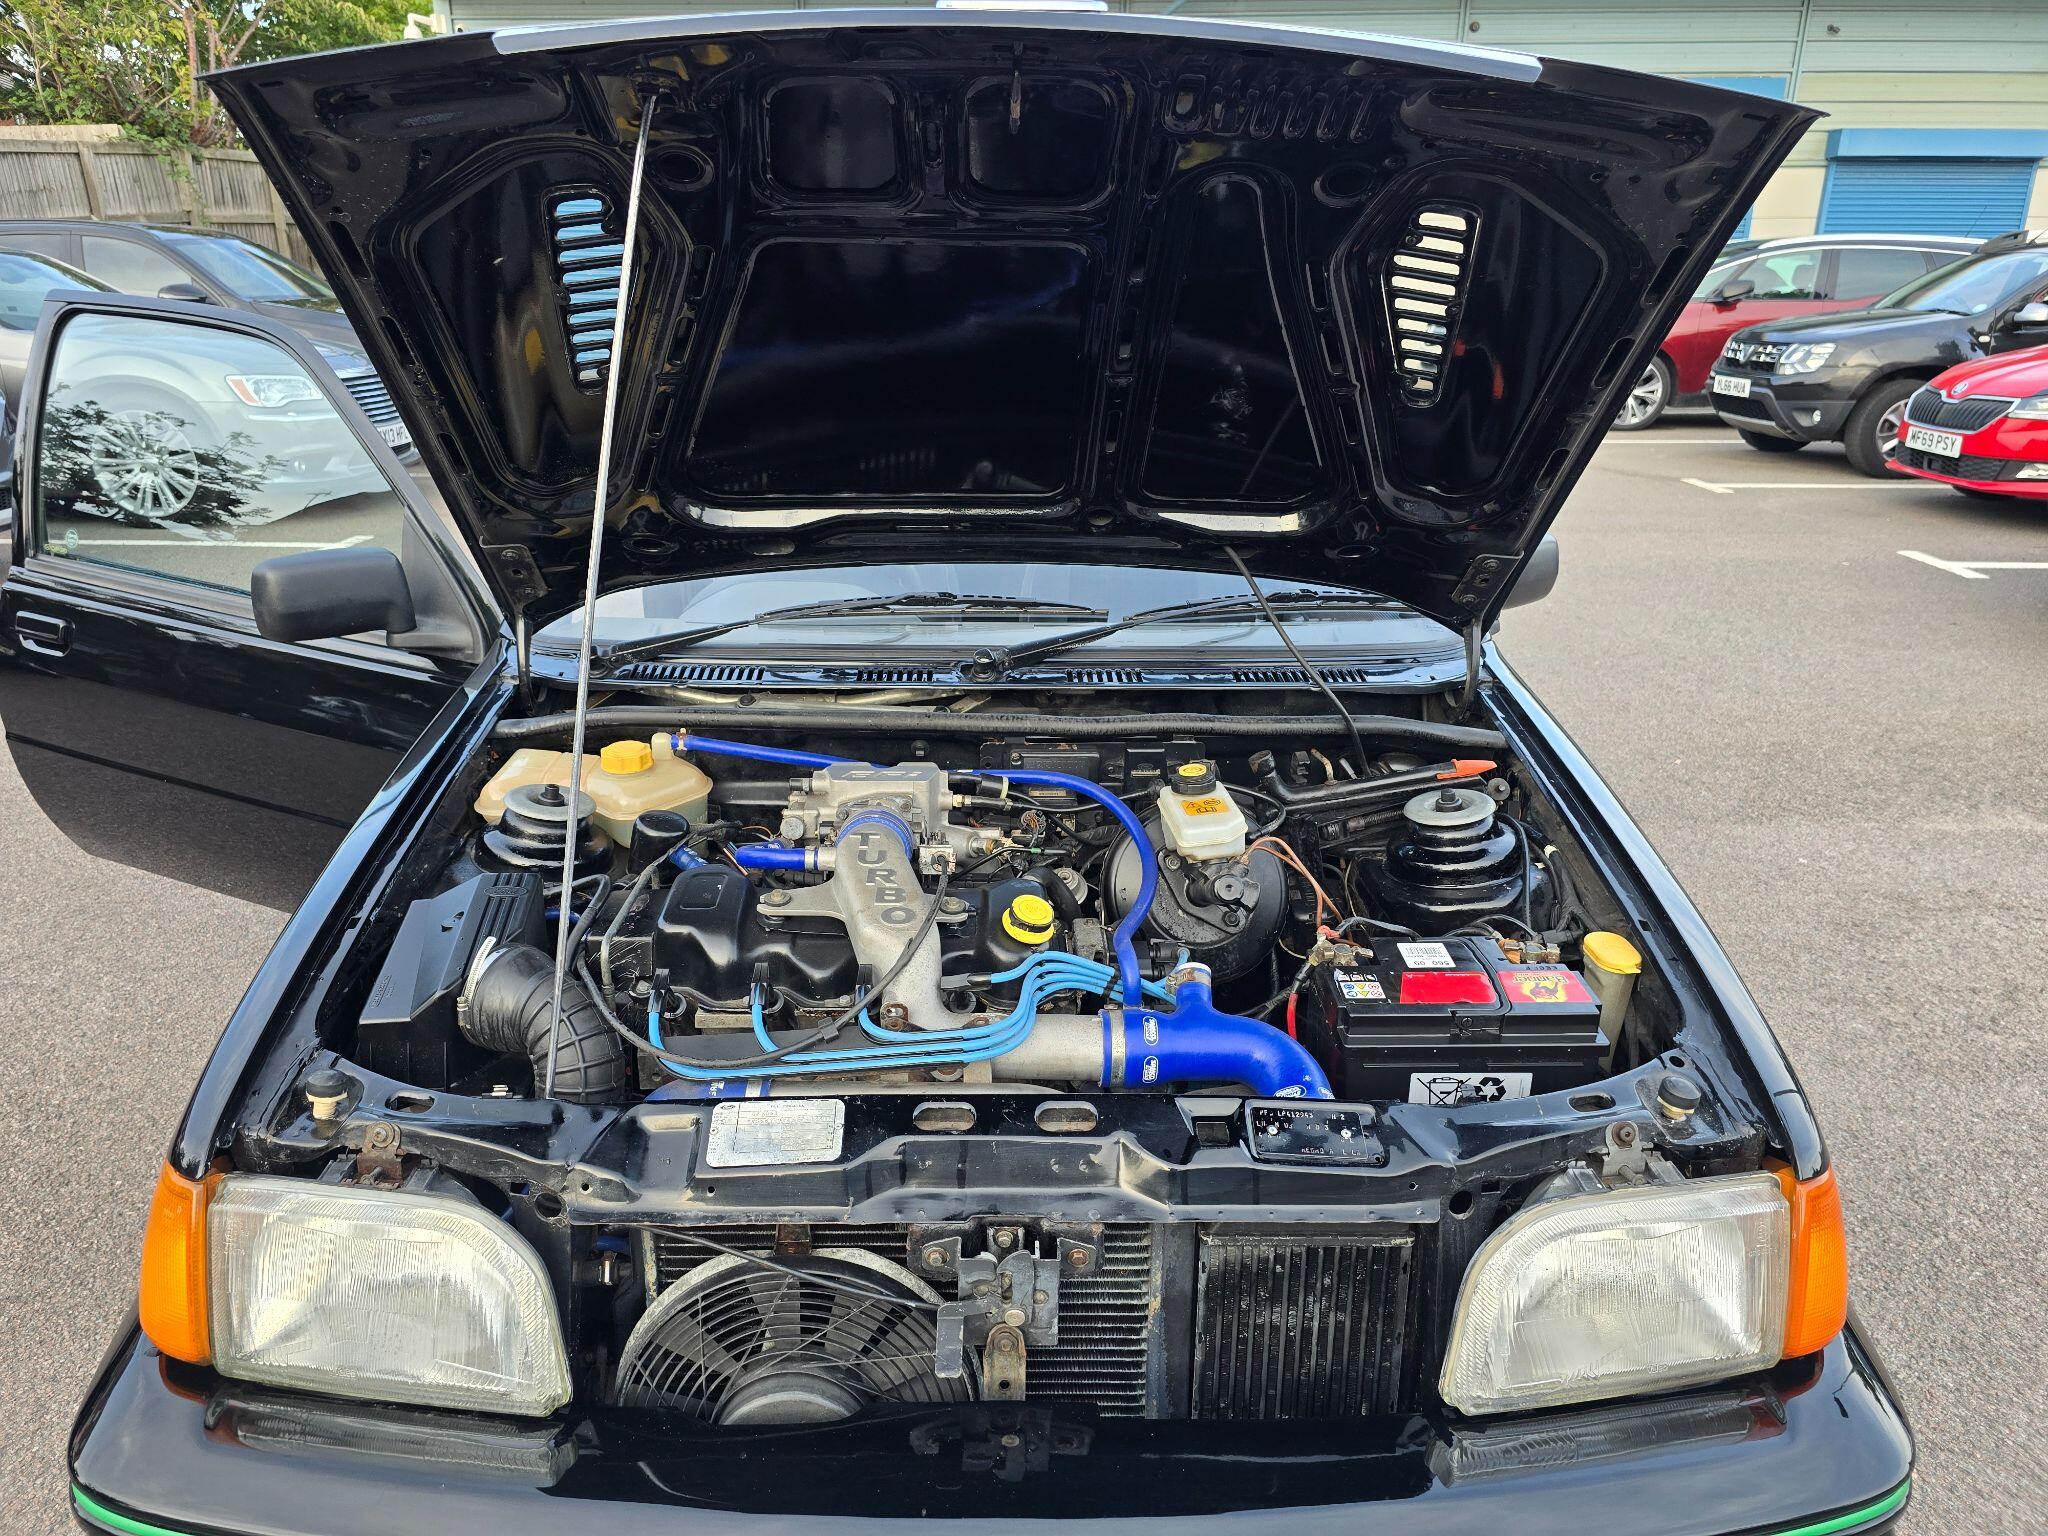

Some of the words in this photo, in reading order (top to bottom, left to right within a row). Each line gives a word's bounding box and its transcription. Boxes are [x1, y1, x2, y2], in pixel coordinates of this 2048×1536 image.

[1909, 428, 1935, 448] MF69
[1935, 434, 1957, 453] PSY
[849, 832, 916, 926] TURBO
[1512, 975, 1569, 984] Banner
